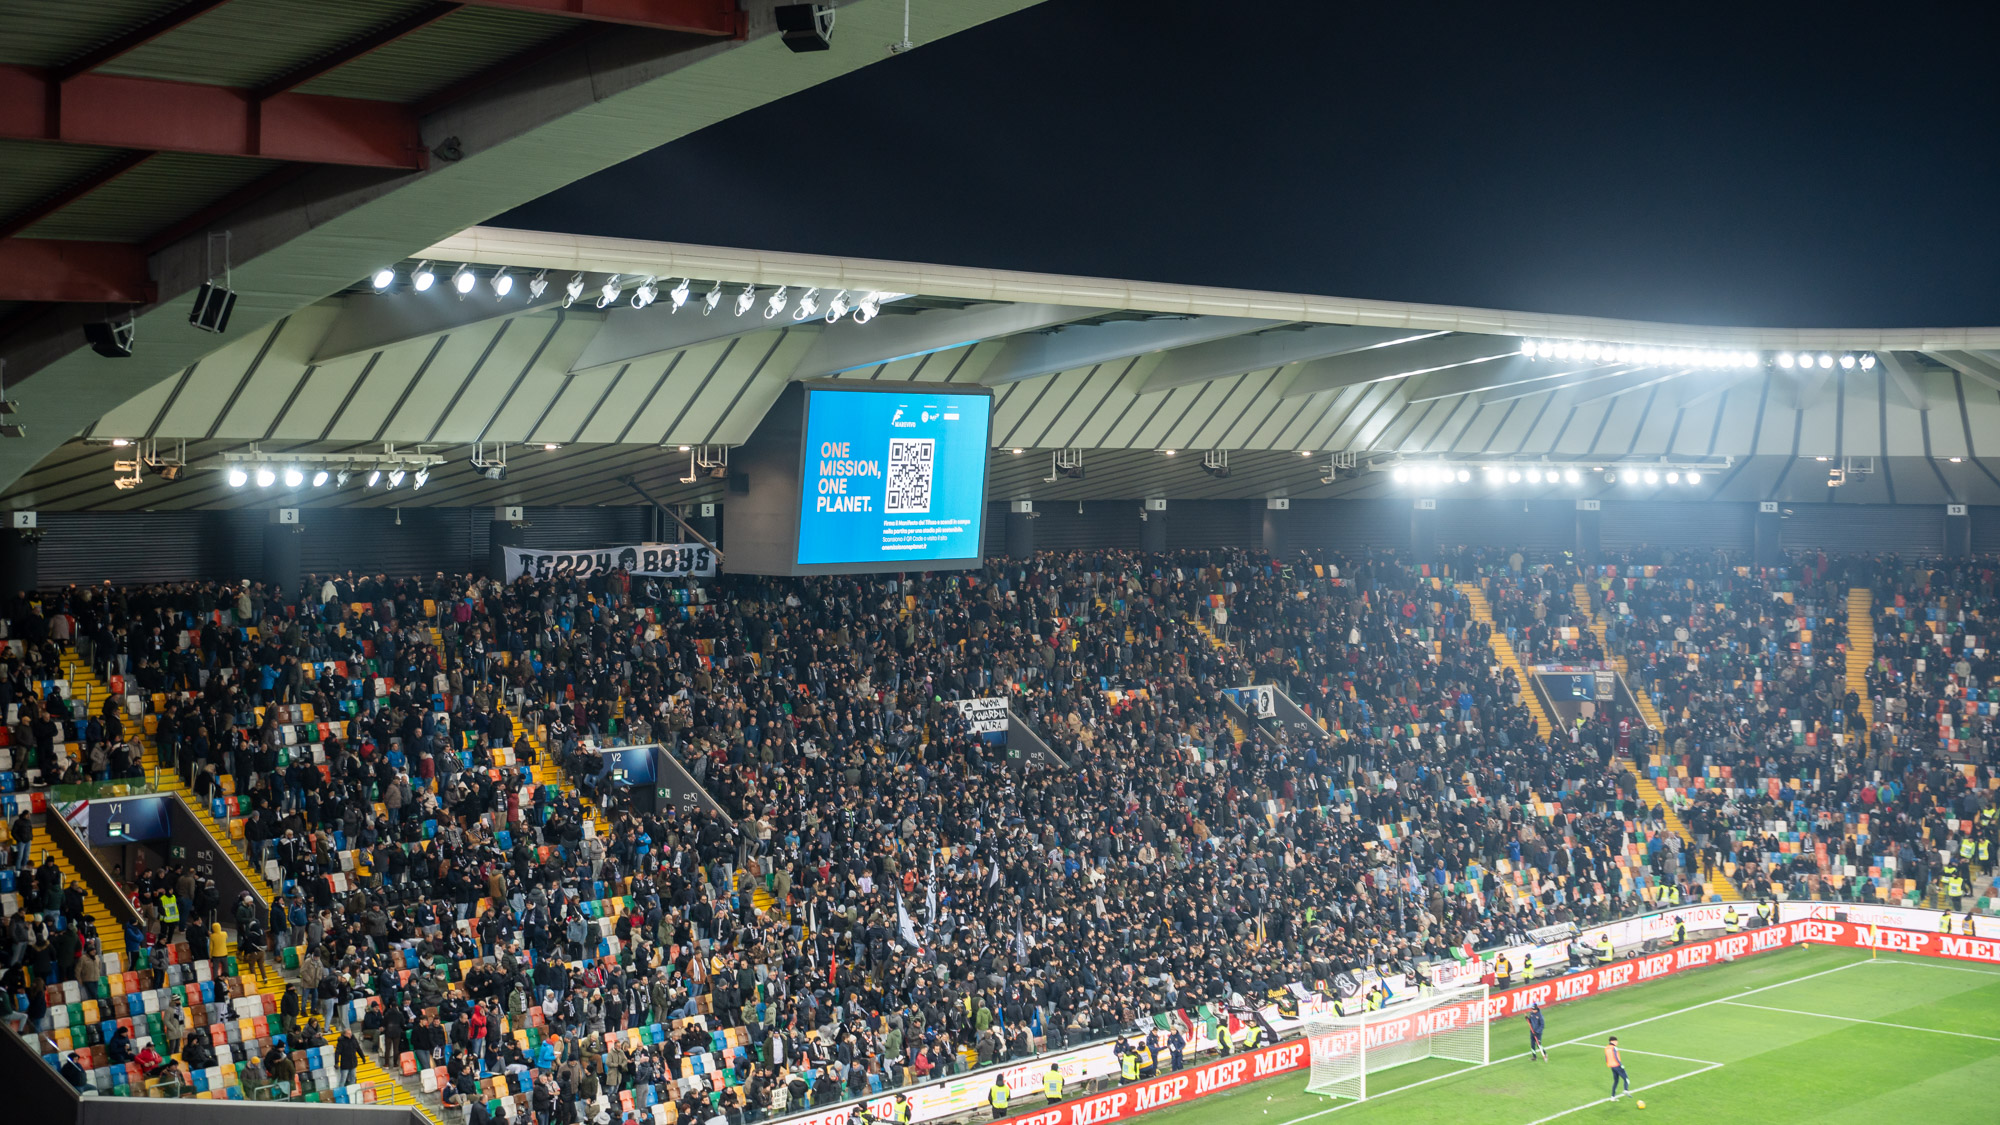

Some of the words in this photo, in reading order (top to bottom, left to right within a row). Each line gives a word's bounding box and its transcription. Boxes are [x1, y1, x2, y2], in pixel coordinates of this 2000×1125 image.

[821, 442, 850, 458] ONE
[820, 460, 882, 479] MISSION,
[818, 478, 847, 494] ONE
[706, 506, 710, 514] 5
[817, 496, 872, 512] PLANET.
[22, 515, 28, 524] 2
[287, 512, 293, 520] 3
[511, 509, 517, 518] 4
[519, 553, 612, 581] TEDDY
[643, 549, 710, 572] BOYS
[1572, 675, 1581, 683] V5
[612, 753, 622, 762] V2
[110, 804, 122, 814] V1
[197, 851, 205, 859] B2
[1665, 908, 1721, 927] SOUTIONS
[1854, 926, 1929, 952] MEP
[1071, 1092, 1128, 1125] MEP
[1134, 1075, 1189, 1112] MEP
[1195, 1058, 1247, 1095] MEP
[1253, 1043, 1305, 1077] MEP
[1311, 1031, 1360, 1058] MEP
[1365, 1019, 1411, 1049] MEP
[1416, 1007, 1461, 1036] MEP
[1511, 983, 1551, 1013] MEP
[1555, 973, 1594, 1002] MEP
[1597, 964, 1634, 990] MEP
[1637, 954, 1673, 980] MEP
[1676, 944, 1712, 969] MEP
[1714, 935, 1749, 961] MEP
[1751, 927, 1787, 952] MEP
[1790, 921, 1844, 943] MEP
